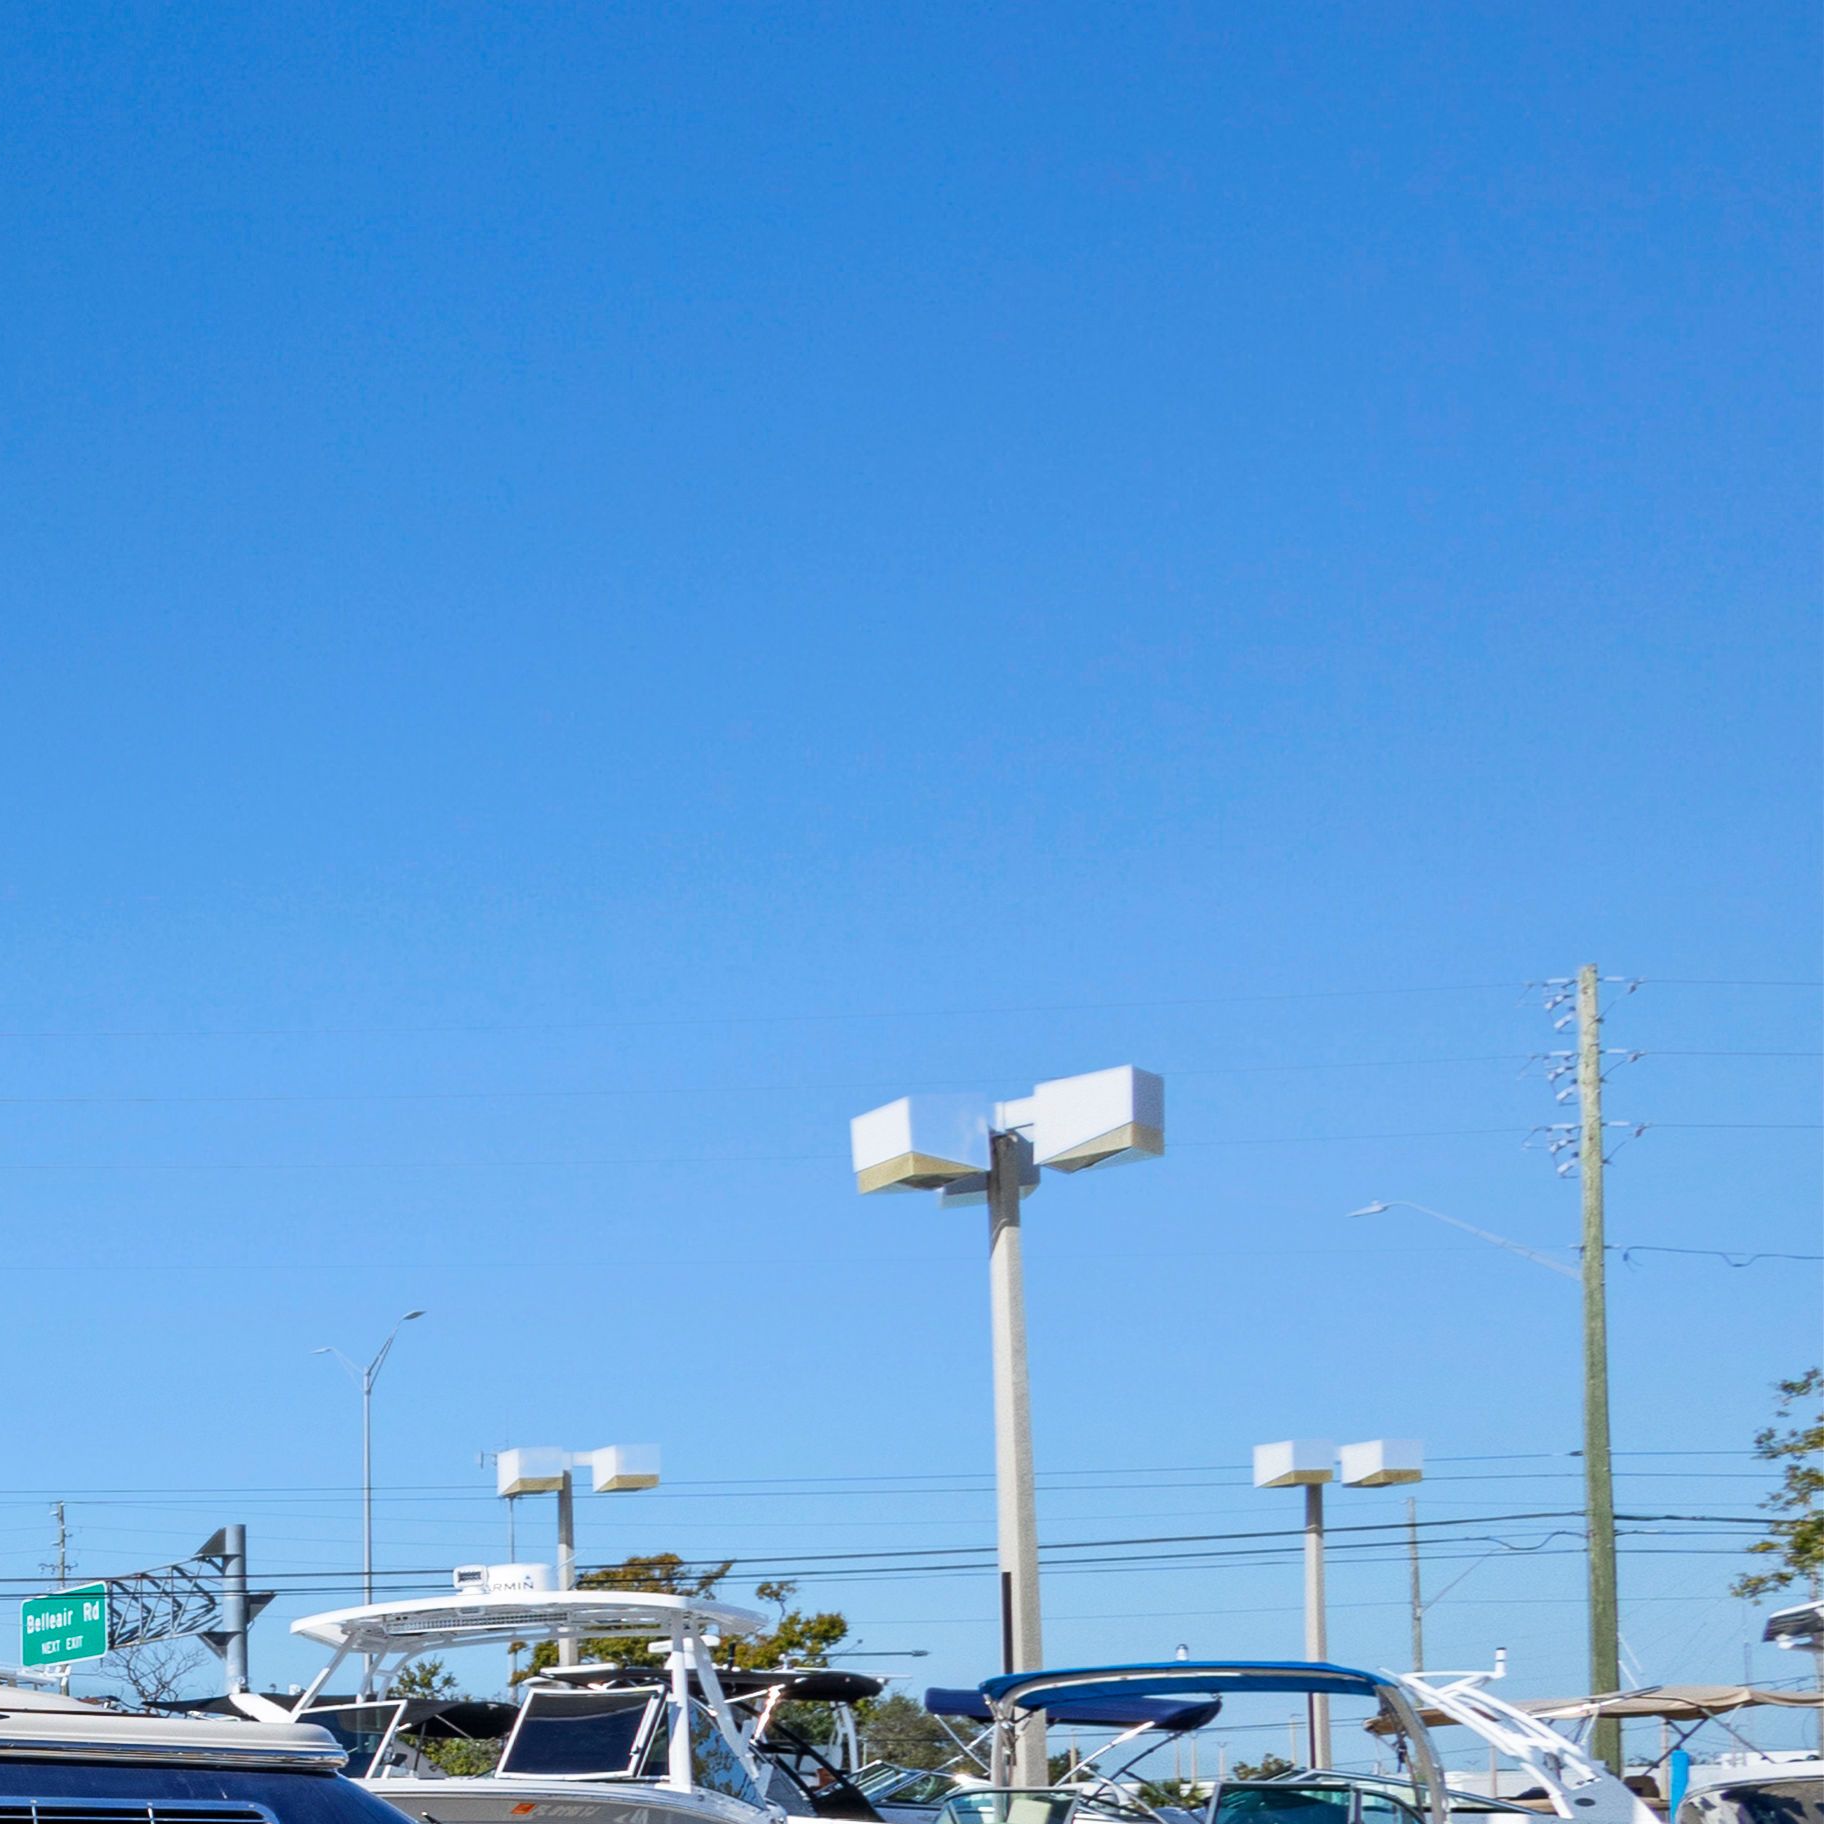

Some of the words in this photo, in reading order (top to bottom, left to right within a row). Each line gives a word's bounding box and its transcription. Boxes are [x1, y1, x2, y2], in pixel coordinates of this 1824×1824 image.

[27, 1607, 73, 1635] Belleair
[83, 1601, 100, 1622] Rd
[41, 1640, 60, 1655] NEXT
[66, 1635, 84, 1650] EXIT
